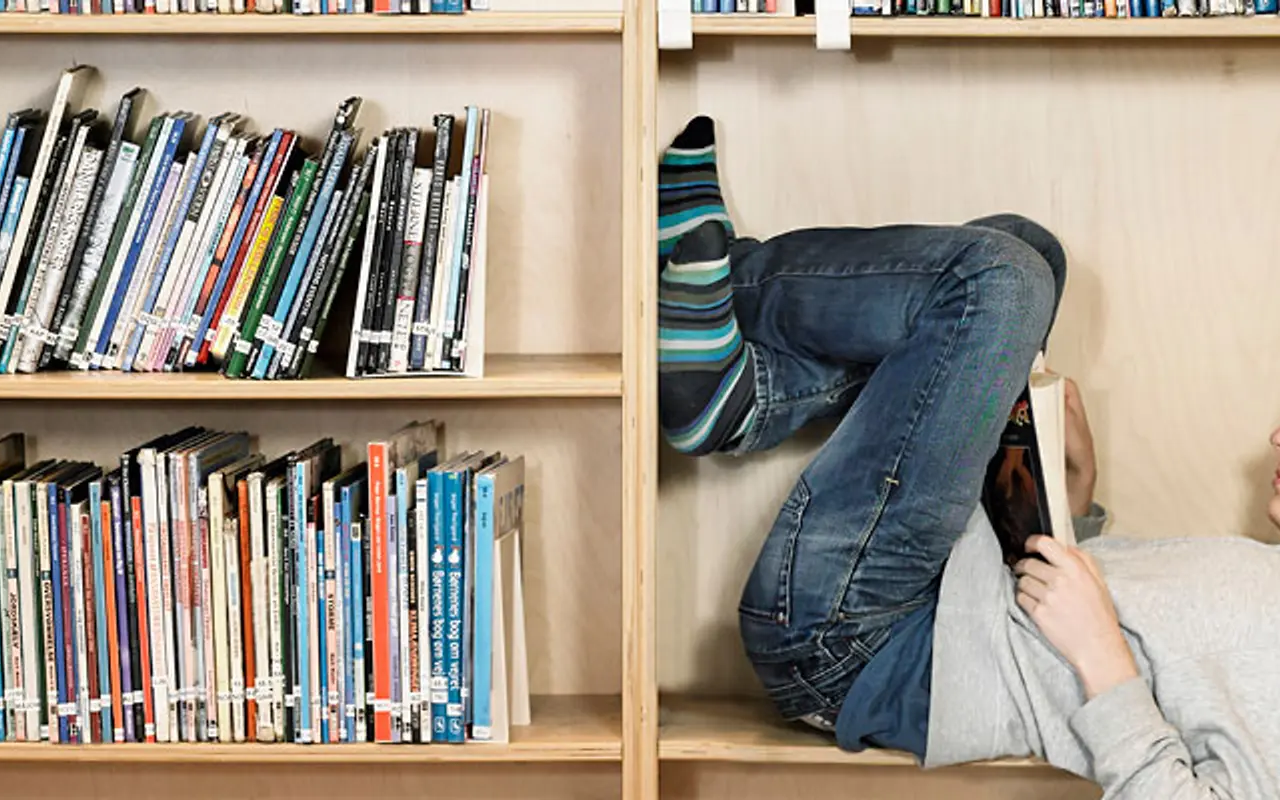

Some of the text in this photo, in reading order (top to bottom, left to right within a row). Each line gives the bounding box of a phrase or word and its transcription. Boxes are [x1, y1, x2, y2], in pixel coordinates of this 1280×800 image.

[327, 592, 335, 631] STORME
[431, 570, 446, 617] Børnenes
[9, 592, 20, 648] JORDSKÆLV
[43, 581, 54, 662] OVERSVØMMELSE
[430, 618, 446, 638] bog
[447, 571, 462, 690] Børnenes bog om vejret
[432, 640, 444, 659] om
